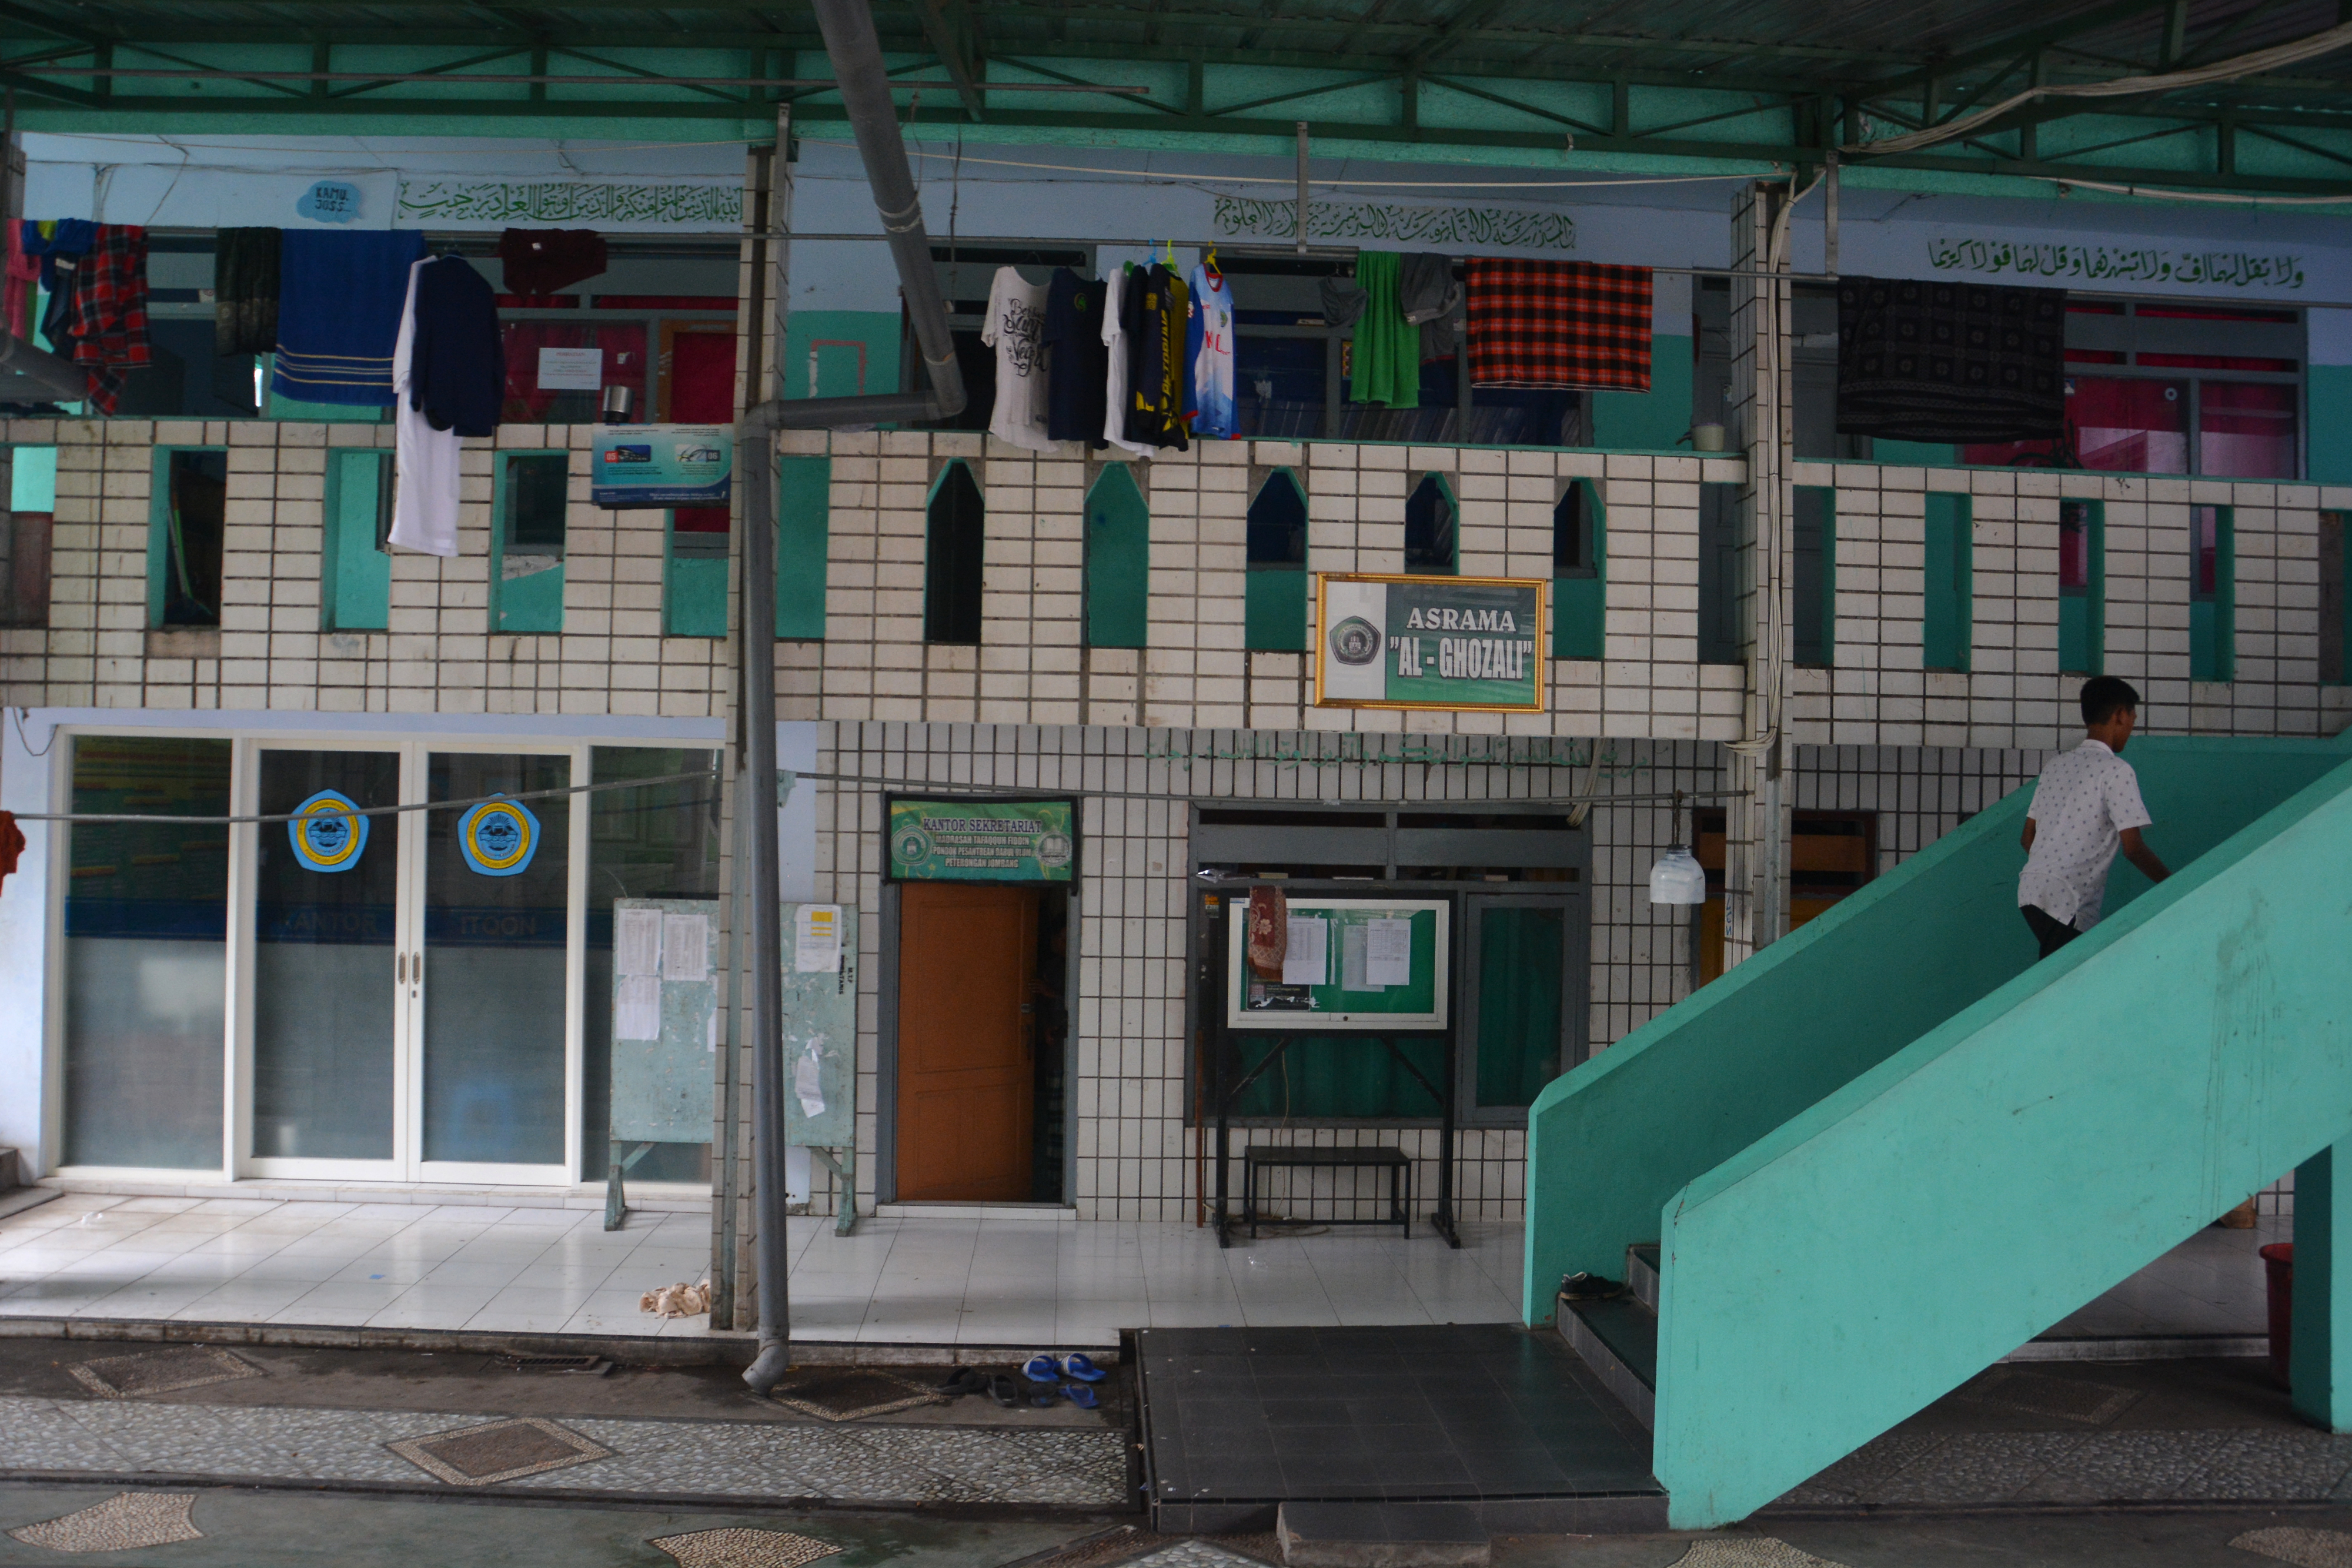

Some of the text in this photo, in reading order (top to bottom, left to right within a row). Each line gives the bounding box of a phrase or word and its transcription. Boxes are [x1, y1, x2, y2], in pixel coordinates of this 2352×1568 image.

[606, 452, 616, 460] 05
[707, 451, 718, 460] 06
[1406, 607, 1516, 633] ASRAMA
[923, 818, 1041, 833] KANTOR SEKRETARIAT
[936, 835, 973, 845] MADRASAH
[974, 836, 1007, 846] TAFAQQUH
[1007, 837, 1030, 845] FIDDIN
[933, 846, 957, 855] PONDOK
[995, 847, 1014, 857] DARUL
[1015, 848, 1031, 857] ULUM
[945, 858, 1019, 868] PETERONGAN JOMBANG
